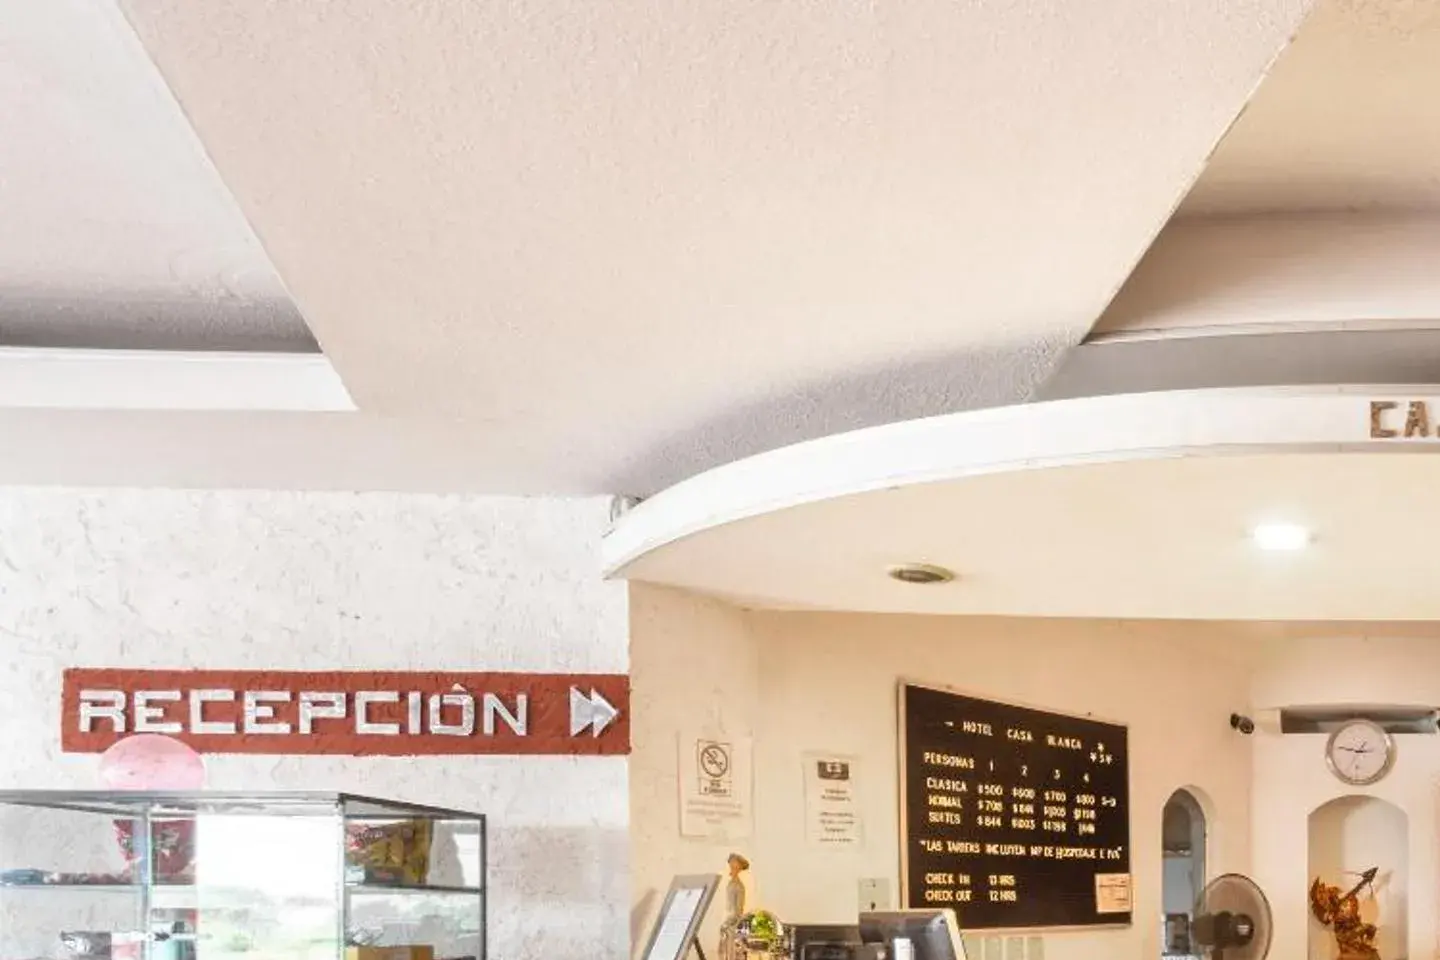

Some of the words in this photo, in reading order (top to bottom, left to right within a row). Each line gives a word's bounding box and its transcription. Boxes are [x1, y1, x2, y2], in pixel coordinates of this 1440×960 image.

[79, 683, 527, 736] RECEPCIÓN
[962, 721, 993, 737] HOTEL
[1007, 728, 1033, 742] CASA
[1046, 734, 1082, 750] BLANCA
[923, 752, 975, 769] PERSONAS
[989, 759, 994, 772] 1
[1021, 765, 1028, 777] 2
[926, 777, 967, 792] CLASICA
[928, 811, 961, 824] SUITES
[925, 873, 954, 885] CHECK
[959, 874, 970, 885] IN
[925, 890, 953, 901] CHECK
[956, 890, 972, 901] OUT
